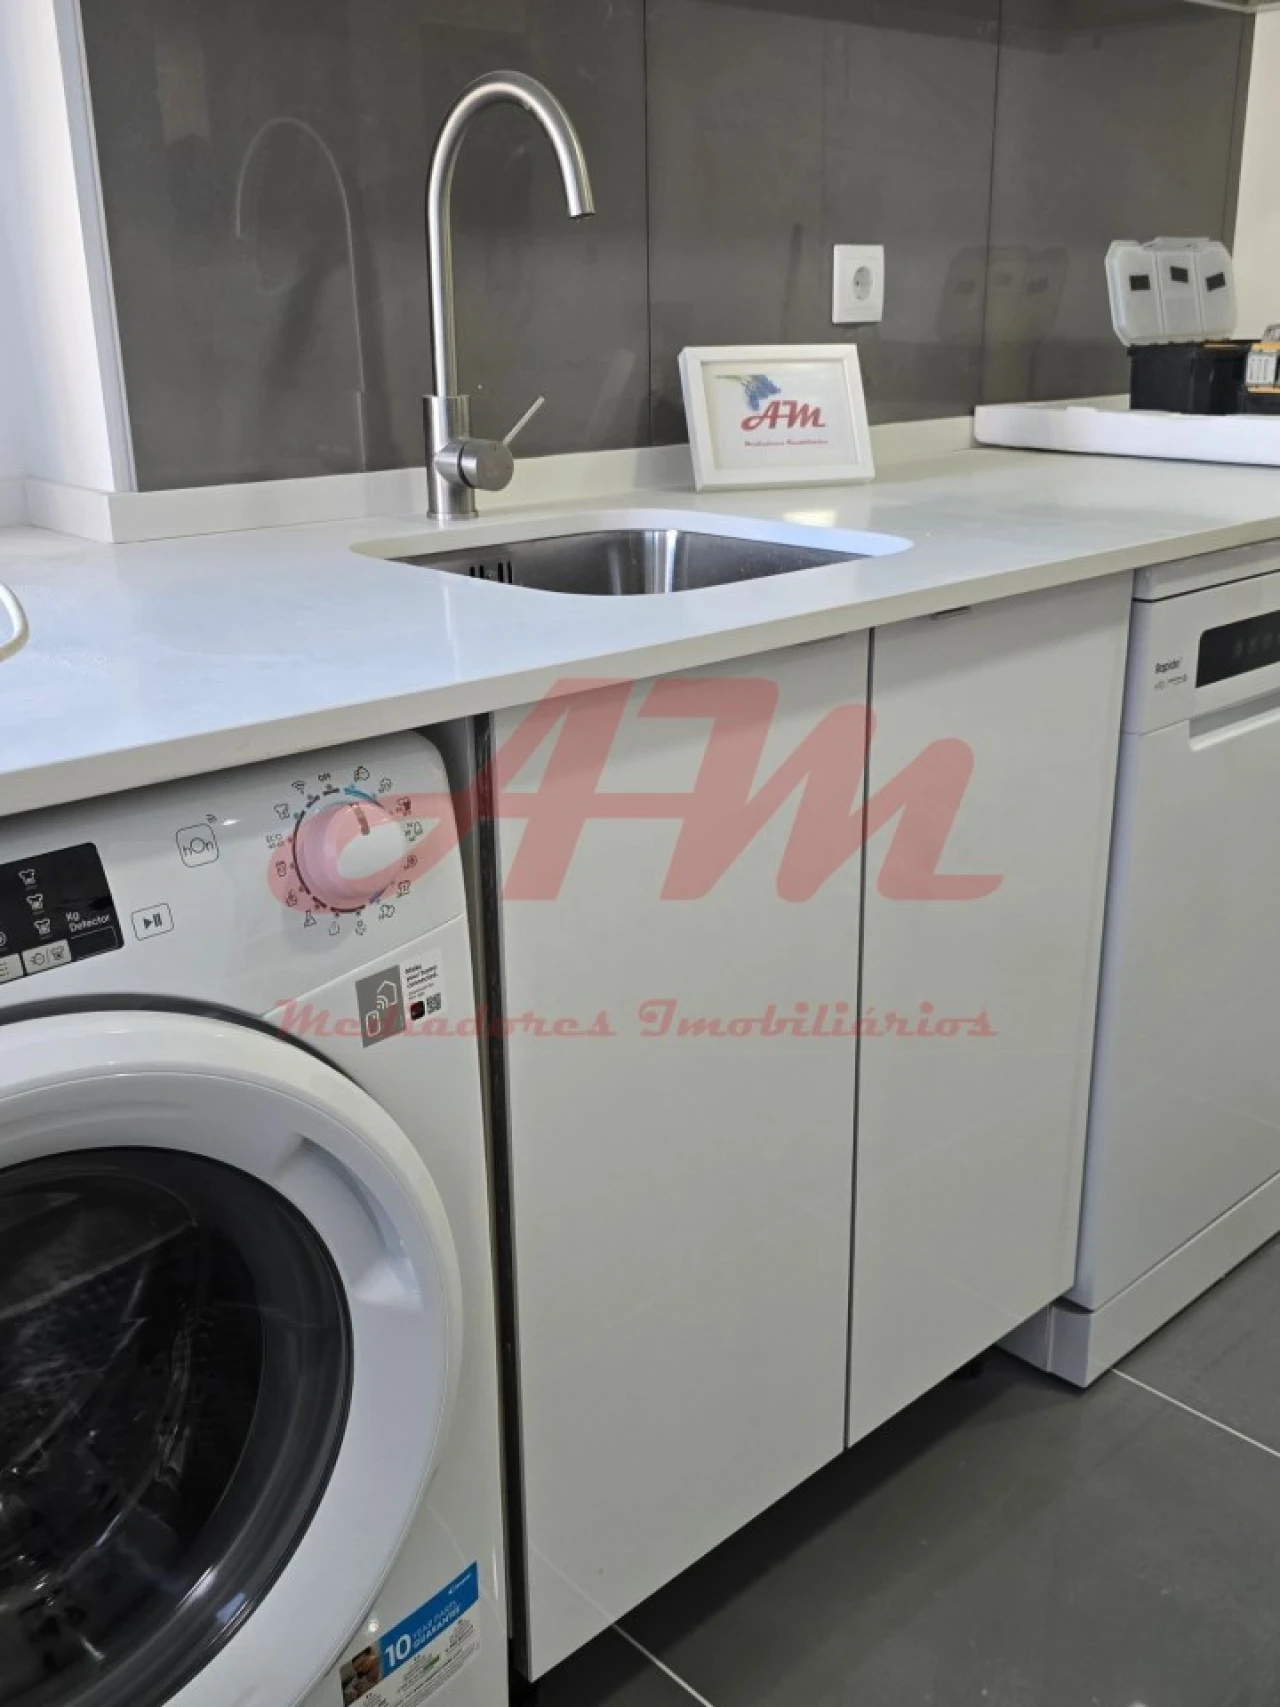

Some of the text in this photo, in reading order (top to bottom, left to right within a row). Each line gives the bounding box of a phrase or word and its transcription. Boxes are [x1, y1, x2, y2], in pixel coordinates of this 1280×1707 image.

[740, 399, 826, 432] AM
[65, 911, 79, 922] Kg
[69, 914, 110, 933] Detector
[385, 1634, 412, 1667] 10
